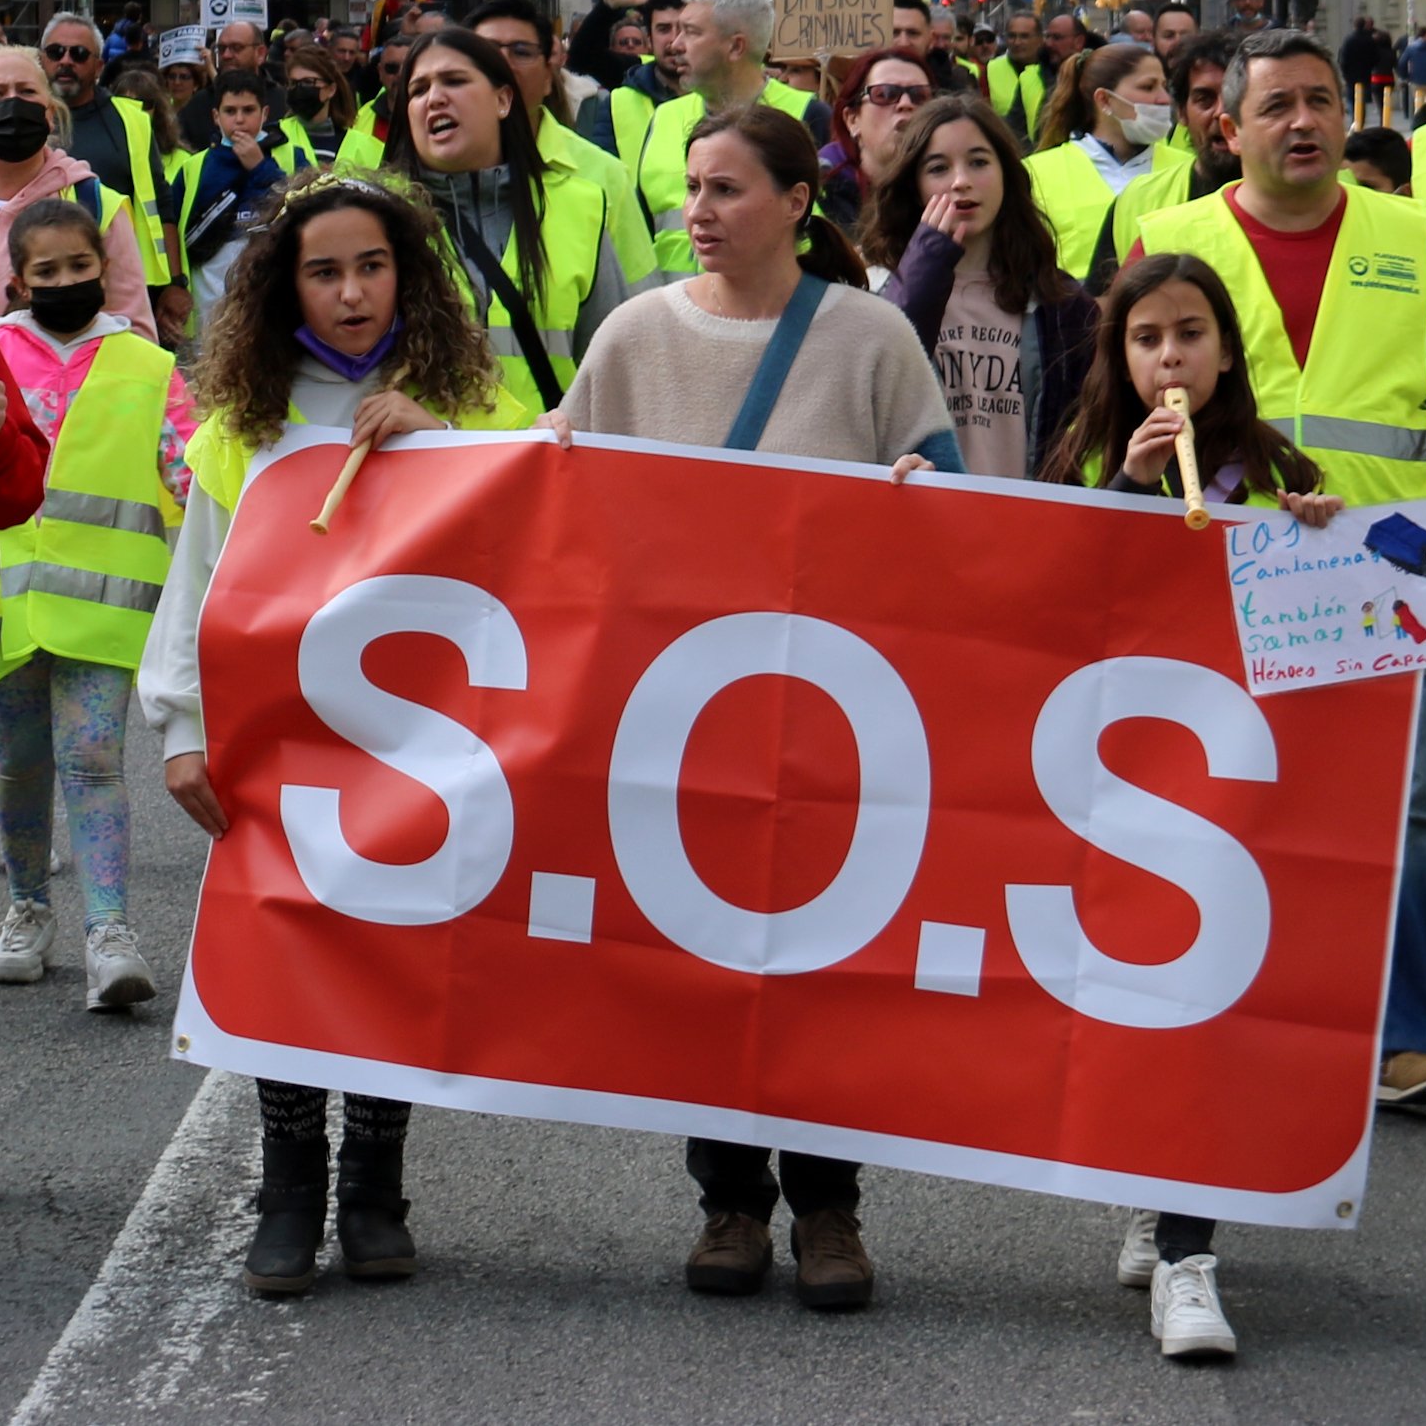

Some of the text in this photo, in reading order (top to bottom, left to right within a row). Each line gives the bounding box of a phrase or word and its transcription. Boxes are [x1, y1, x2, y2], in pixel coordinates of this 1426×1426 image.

[778, 12, 886, 49] CRIMINALES
[972, 325, 1021, 348] REGION
[978, 396, 1020, 414] LEAGUE
[280, 574, 1278, 1029] S.O.S
